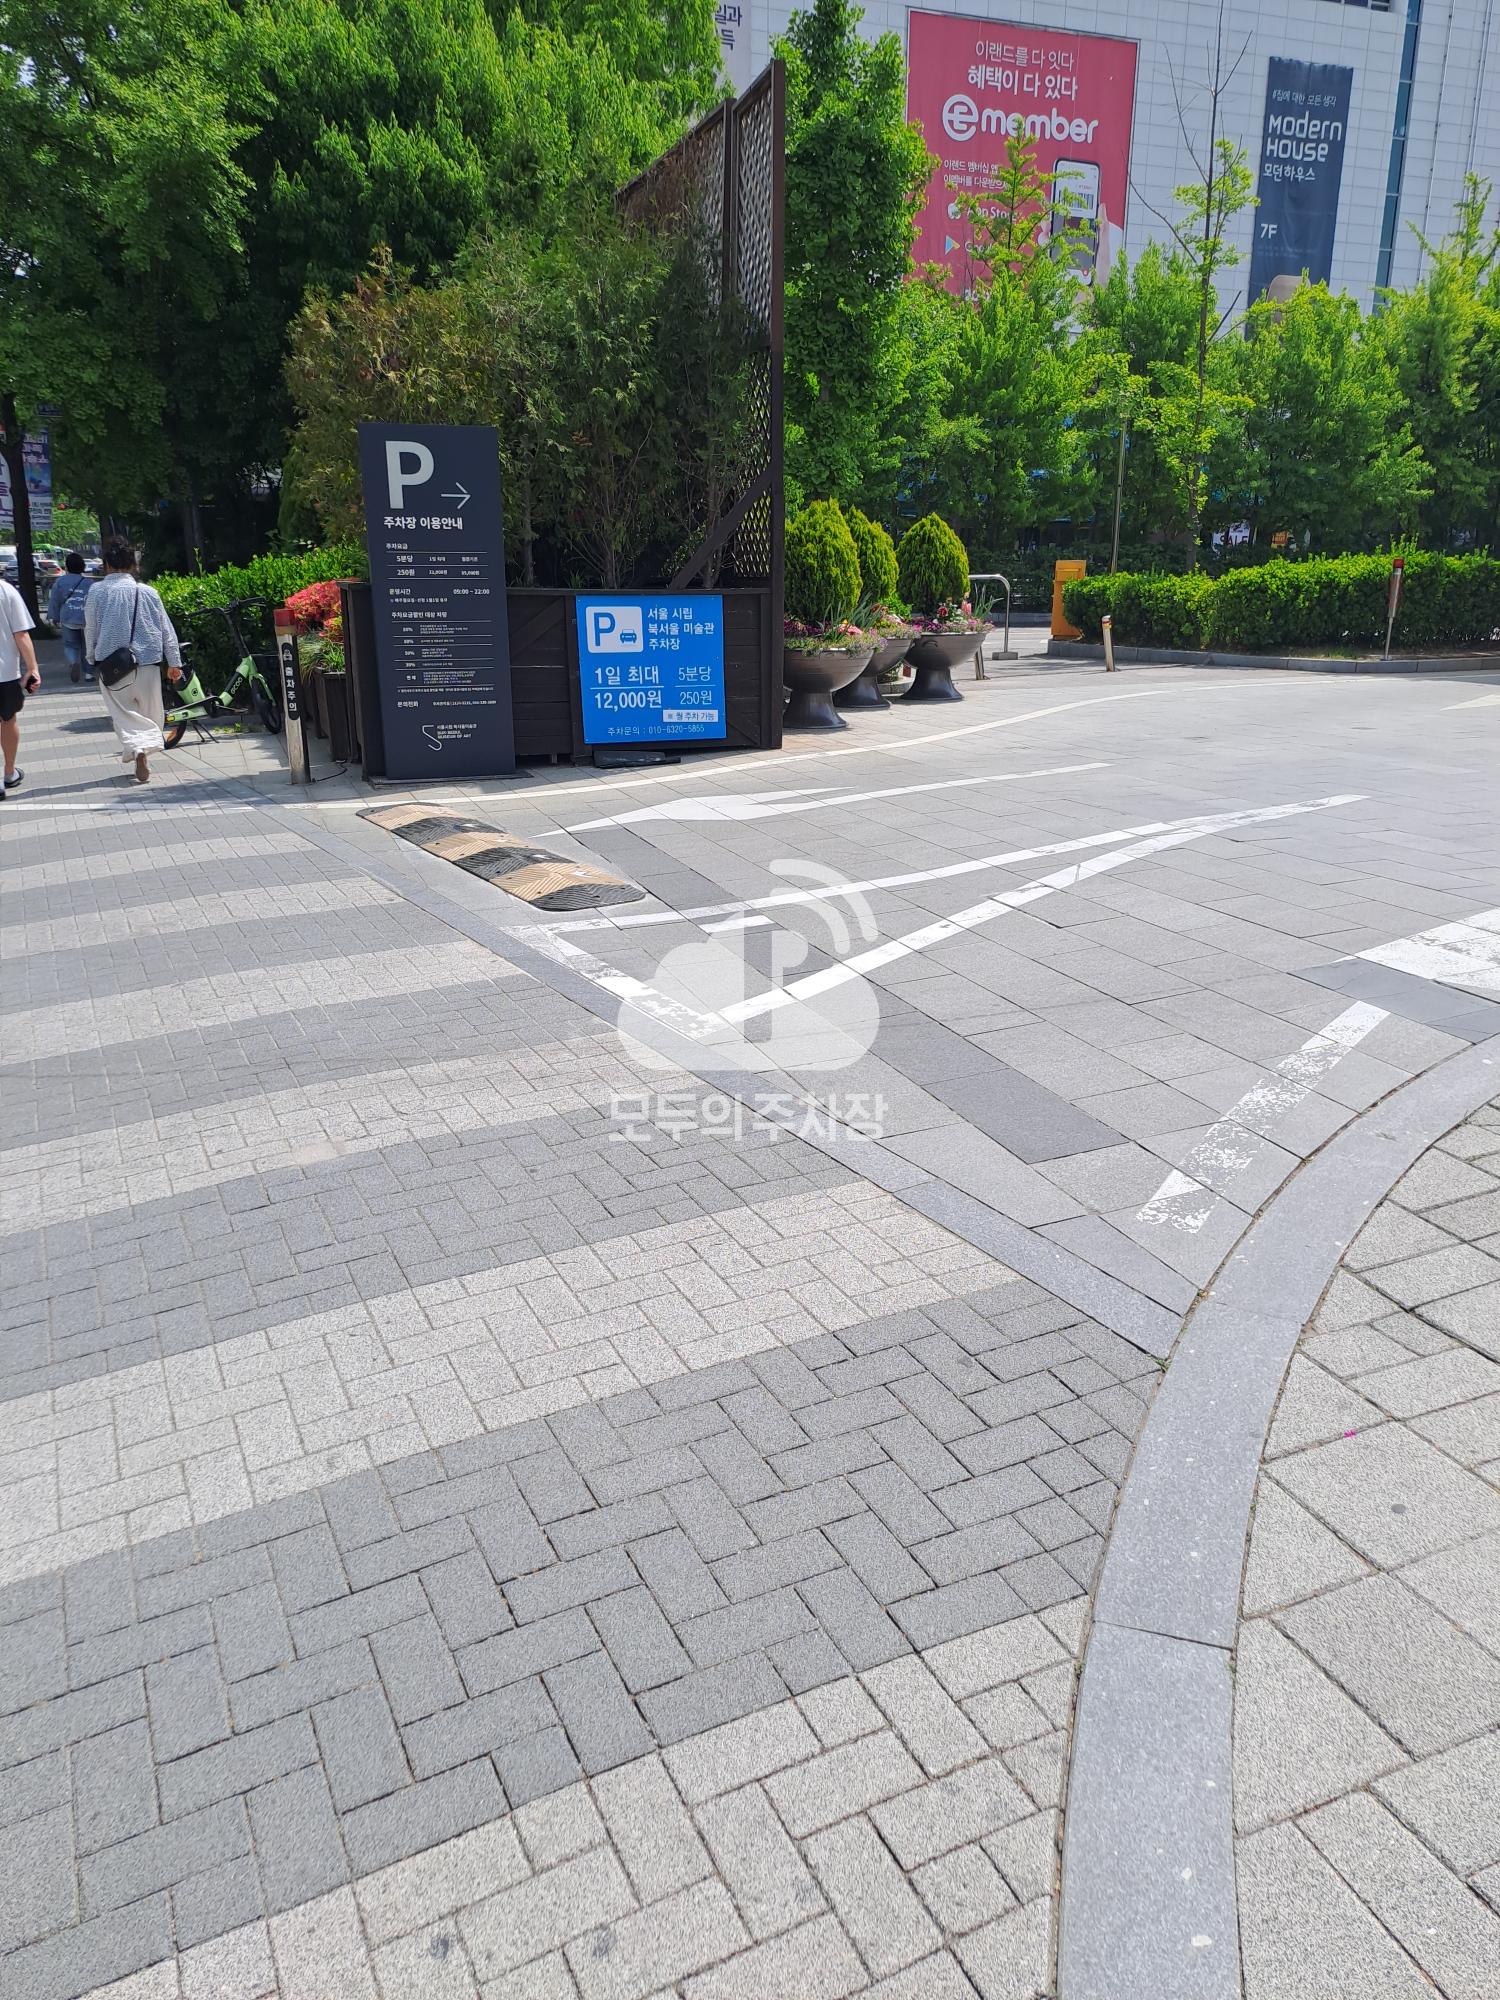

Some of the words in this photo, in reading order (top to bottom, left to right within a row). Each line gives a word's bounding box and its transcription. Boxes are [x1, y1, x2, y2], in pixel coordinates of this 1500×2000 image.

[975, 40, 1028, 67] 이랜드를
[1031, 48, 1045, 69] 다
[1048, 50, 1075, 72] 잇다
[968, 64, 1019, 96] 혜택이
[1023, 72, 1041, 98] 다
[1044, 74, 1078, 101] 있다
[1263, 163, 1316, 182] 모던하우스
[1260, 223, 1278, 239] 7F
[385, 440, 435, 509] P
[383, 516, 417, 529] 주차장
[420, 516, 463, 530] 이용안내
[648, 608, 668, 620] 서울
[672, 608, 693, 620] 시립
[593, 612, 616, 647] P
[648, 623, 680, 635] 북서울
[683, 622, 715, 635] 미술관
[649, 638, 680, 651] 주차장
[594, 666, 621, 685] 1일
[628, 665, 659, 685] 최대
[678, 666, 712, 682] 5분당
[594, 690, 662, 712] 12,000원
[680, 690, 713, 705] 250원
[607, 725, 640, 736] 주차문의
